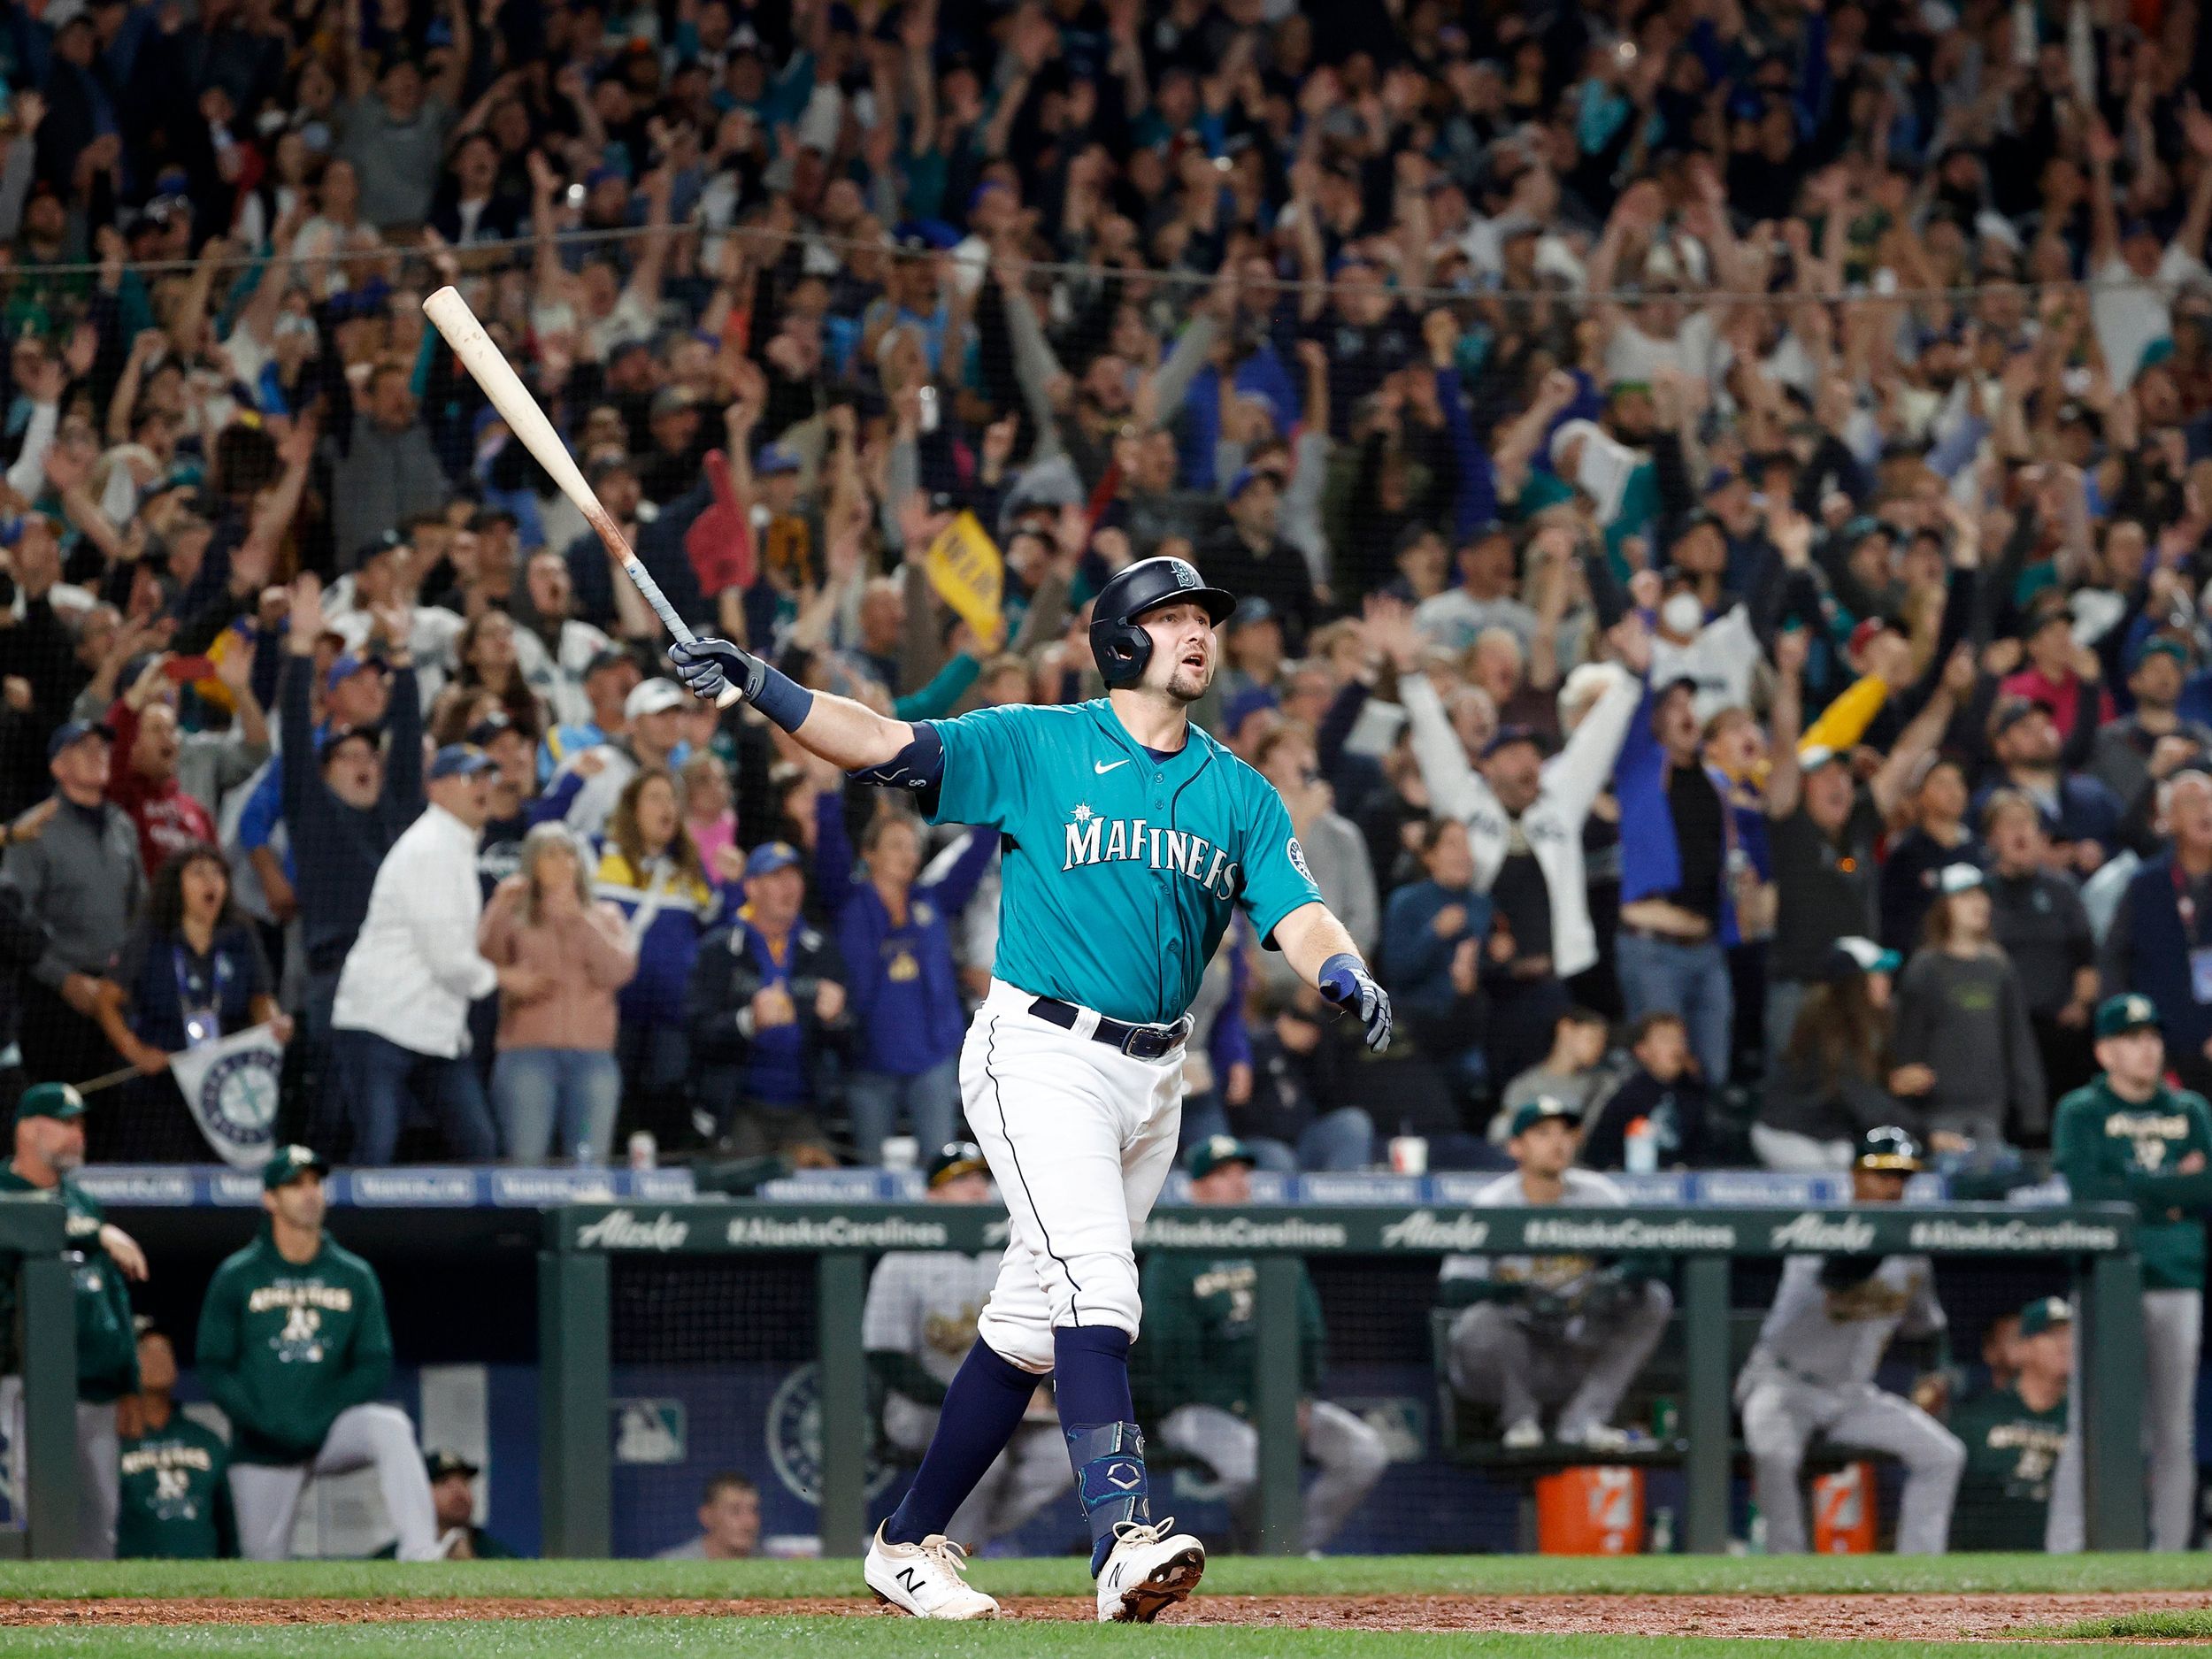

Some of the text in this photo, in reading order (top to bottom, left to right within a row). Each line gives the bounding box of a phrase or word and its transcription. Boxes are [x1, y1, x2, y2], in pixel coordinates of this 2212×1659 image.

[578, 1210, 690, 1252] Alaska
[1380, 1210, 1489, 1250] Alaska
[1770, 1212, 1876, 1254] Alaska
